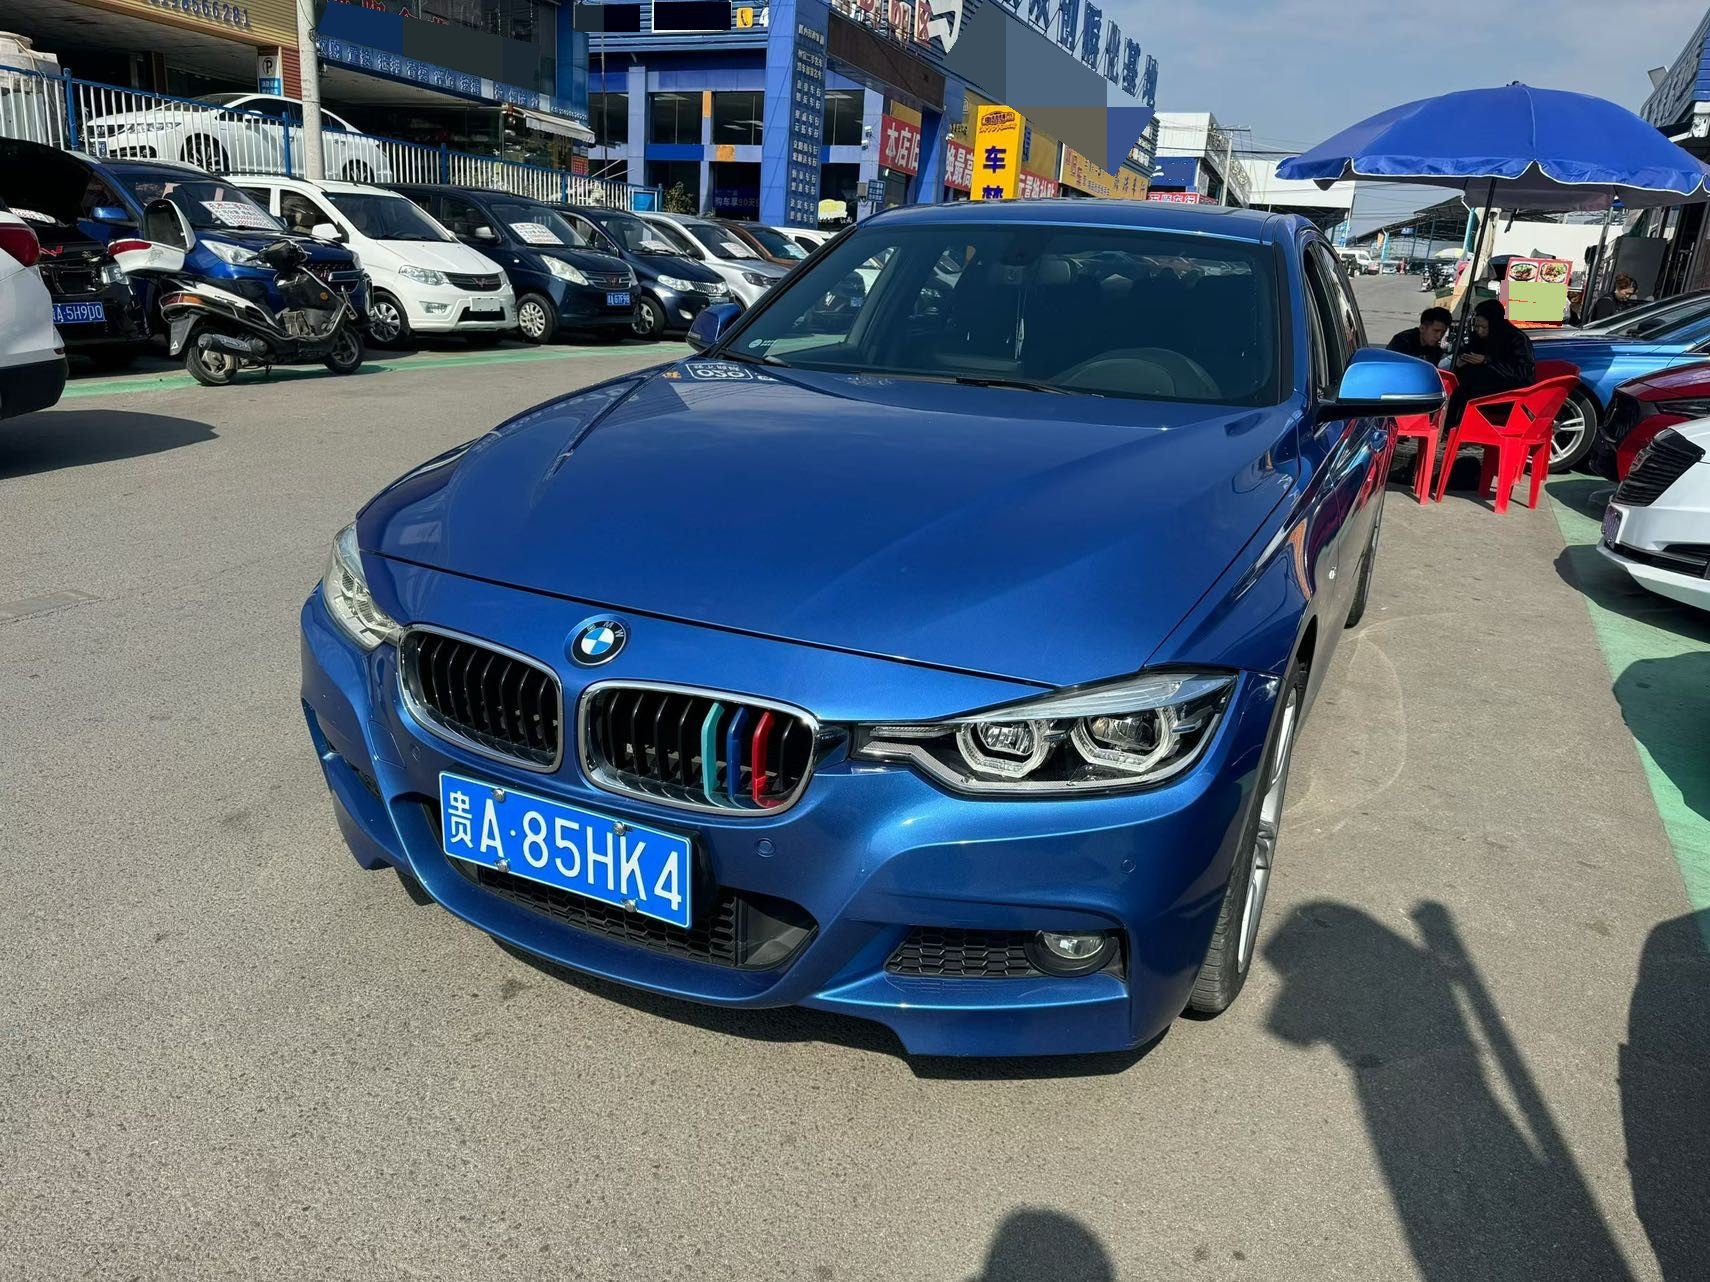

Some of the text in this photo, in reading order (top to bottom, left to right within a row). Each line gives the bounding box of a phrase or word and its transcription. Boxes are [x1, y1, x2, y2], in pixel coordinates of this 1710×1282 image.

[1001, 0, 1158, 107] 创孵化基地
[587, 621, 625, 638] BMW
[447, 788, 684, 912] 贵A·85HK4
